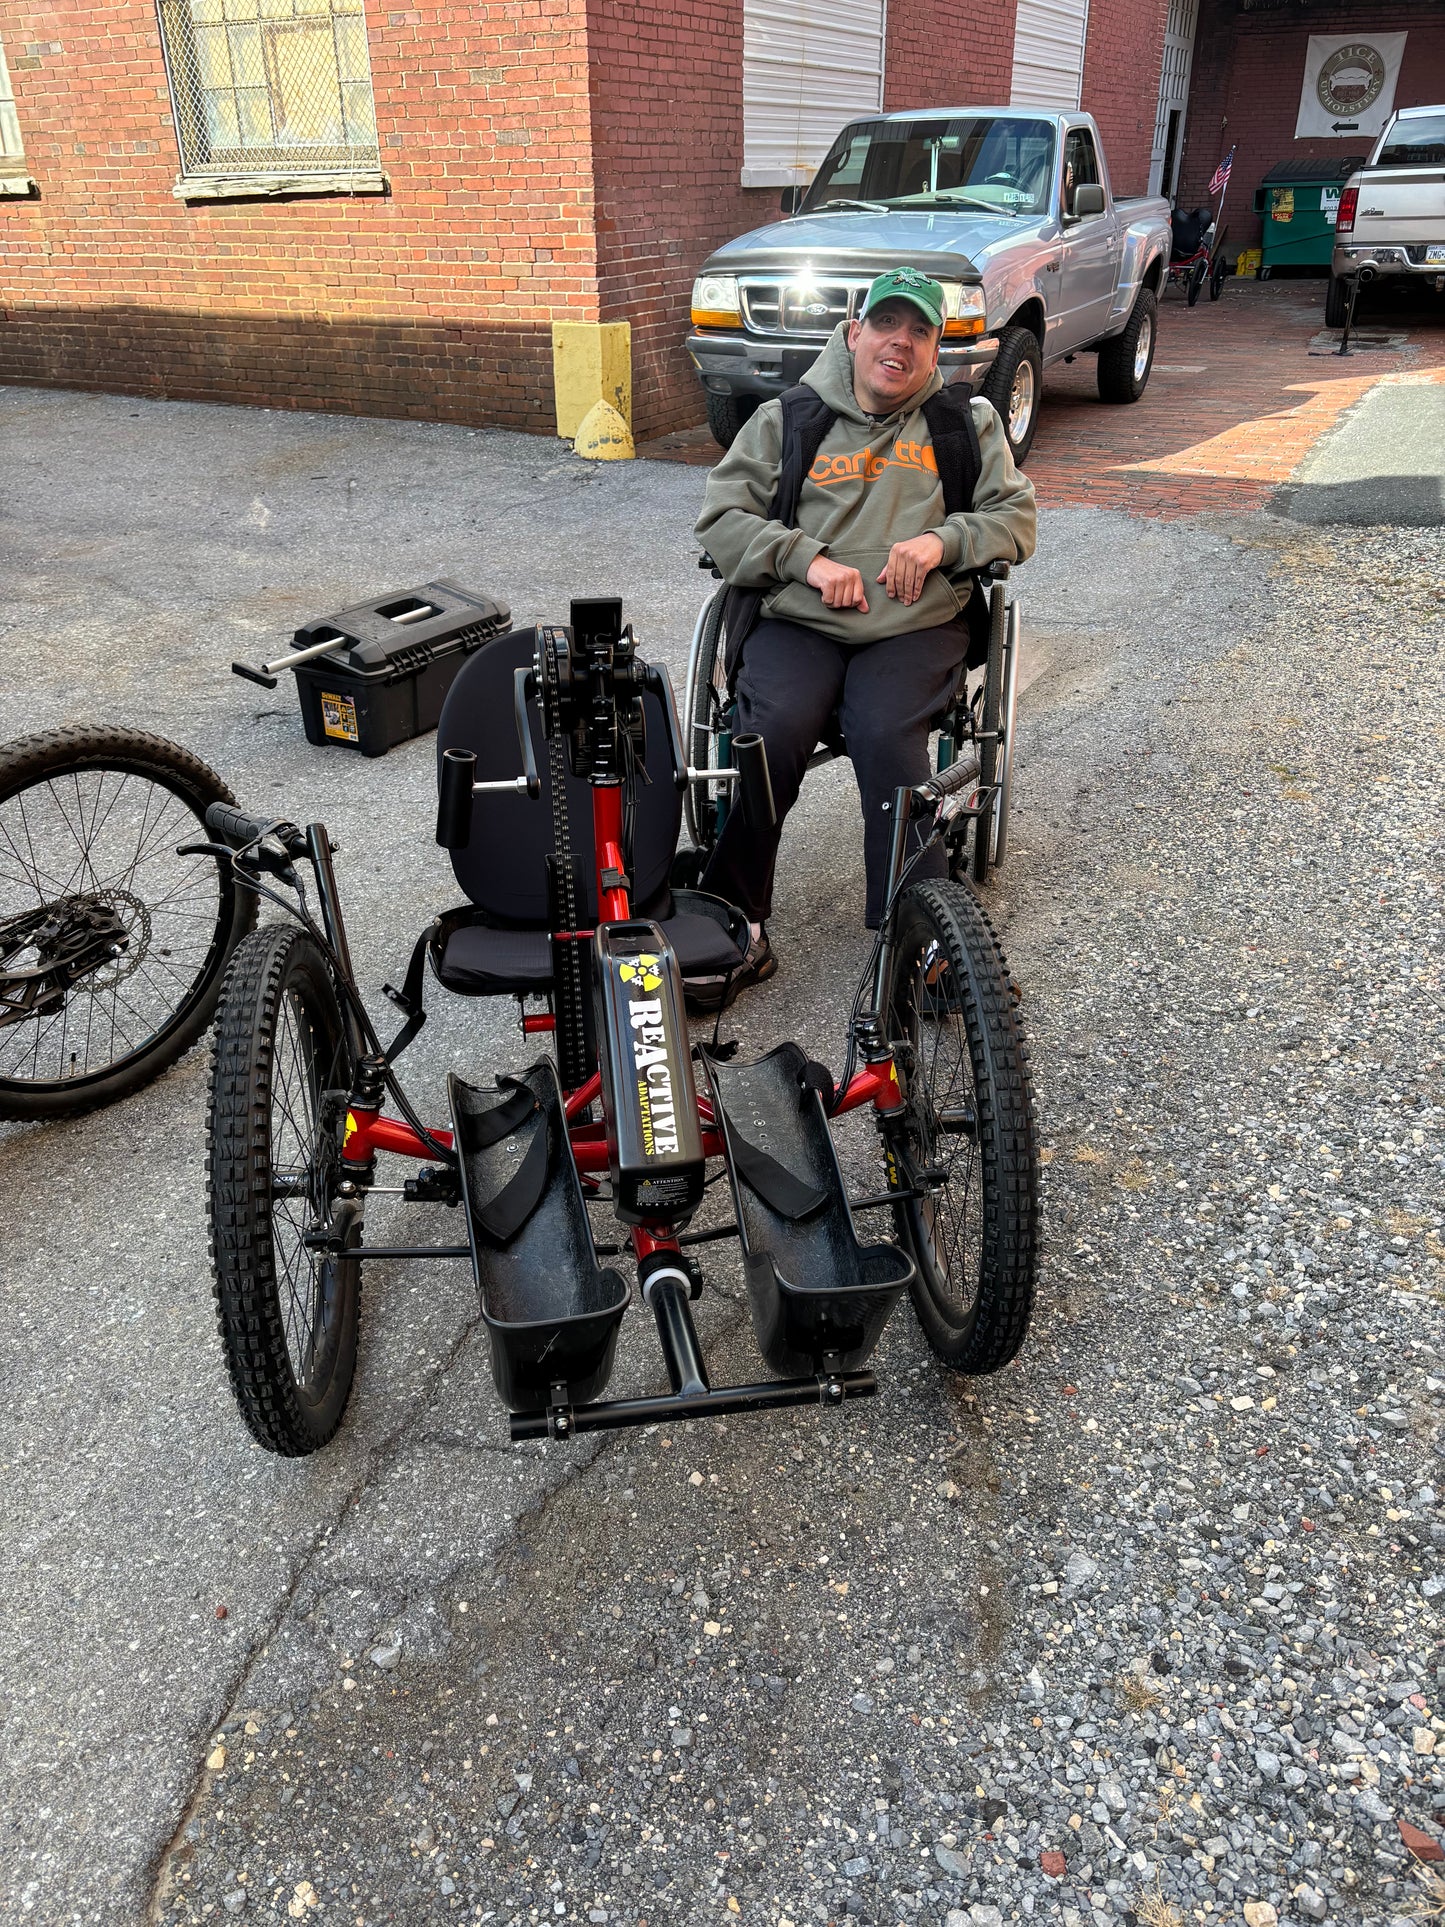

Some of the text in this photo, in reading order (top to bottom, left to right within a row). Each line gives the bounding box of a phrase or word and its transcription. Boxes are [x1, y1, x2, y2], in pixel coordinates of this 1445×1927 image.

[1335, 47, 1377, 64] TICE
[1321, 80, 1380, 112] UPHOLSTERY
[628, 998, 680, 1155] REACTIVE
[637, 1080, 655, 1156] ADAPTATIONS
[652, 1177, 684, 1185] ATTENTION
